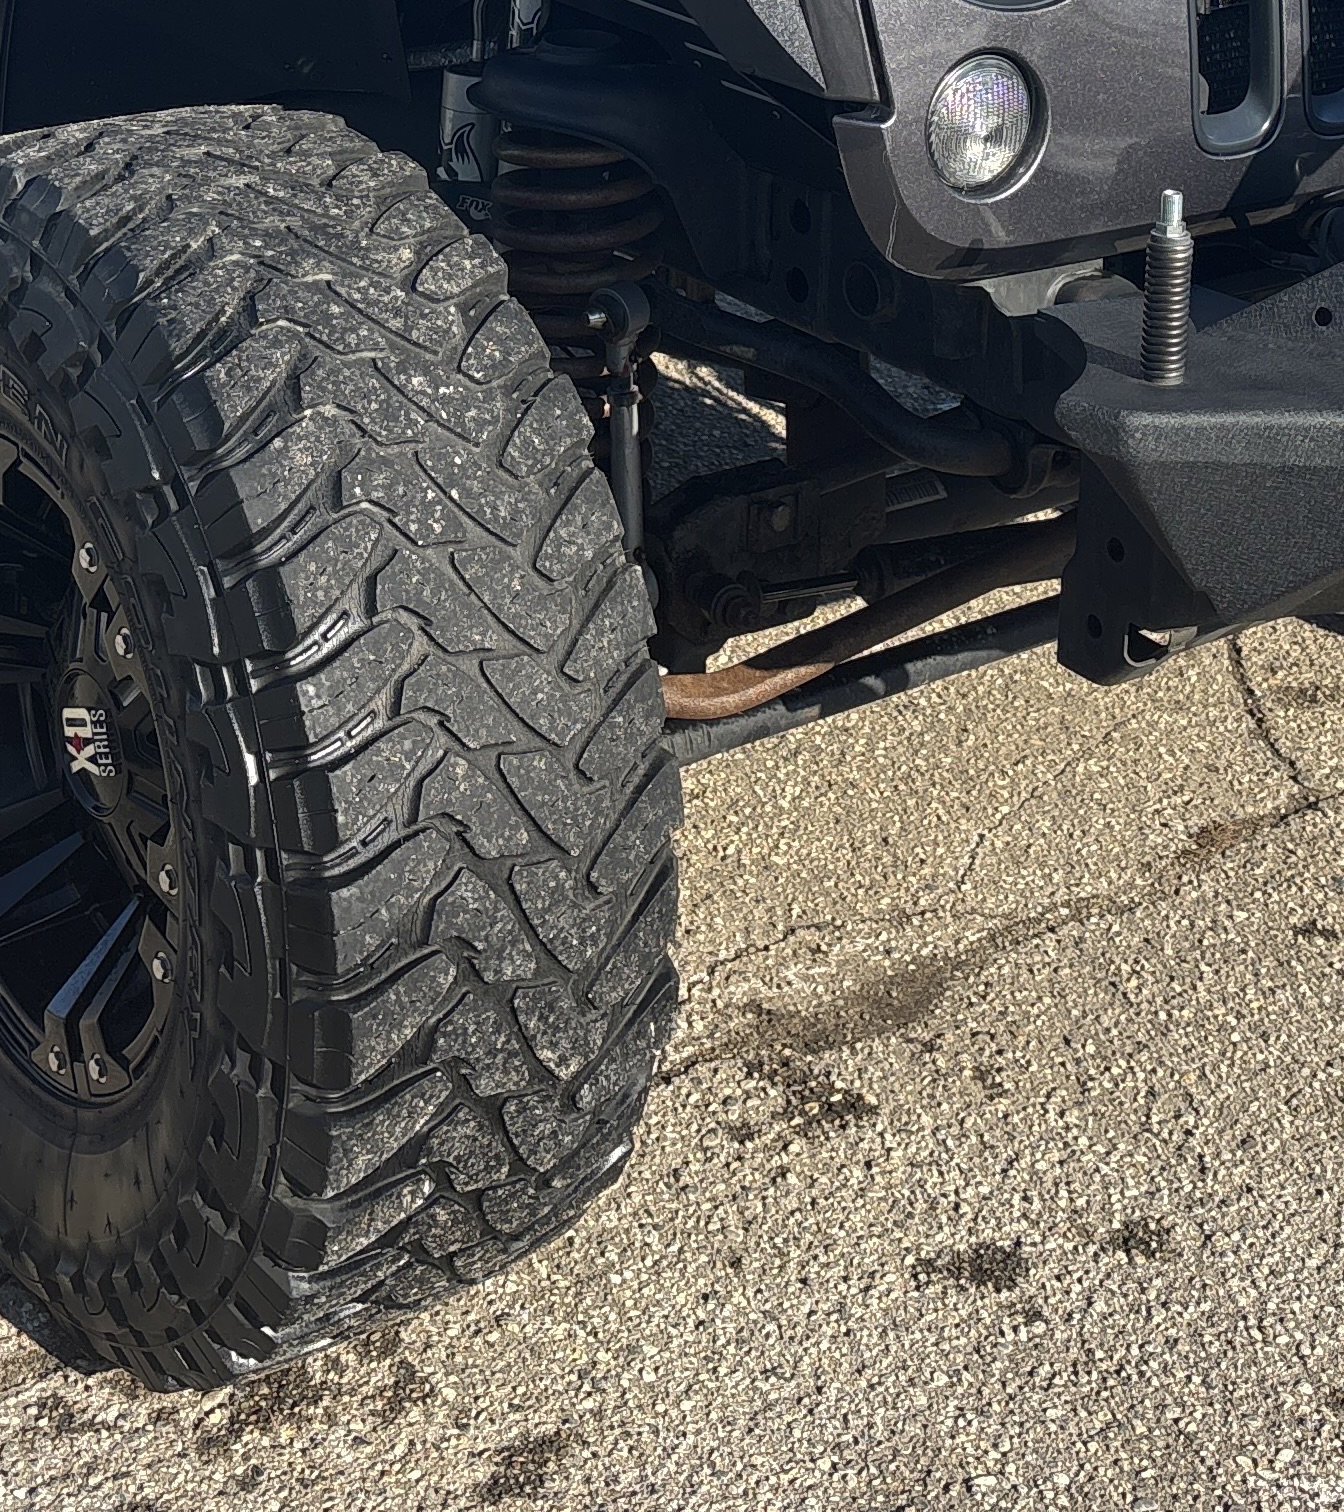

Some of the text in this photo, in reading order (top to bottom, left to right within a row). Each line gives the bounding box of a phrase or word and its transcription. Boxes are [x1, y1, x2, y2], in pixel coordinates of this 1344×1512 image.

[456, 194, 493, 216] FOX
[61, 707, 100, 777] XD
[91, 709, 116, 778] SERIES
